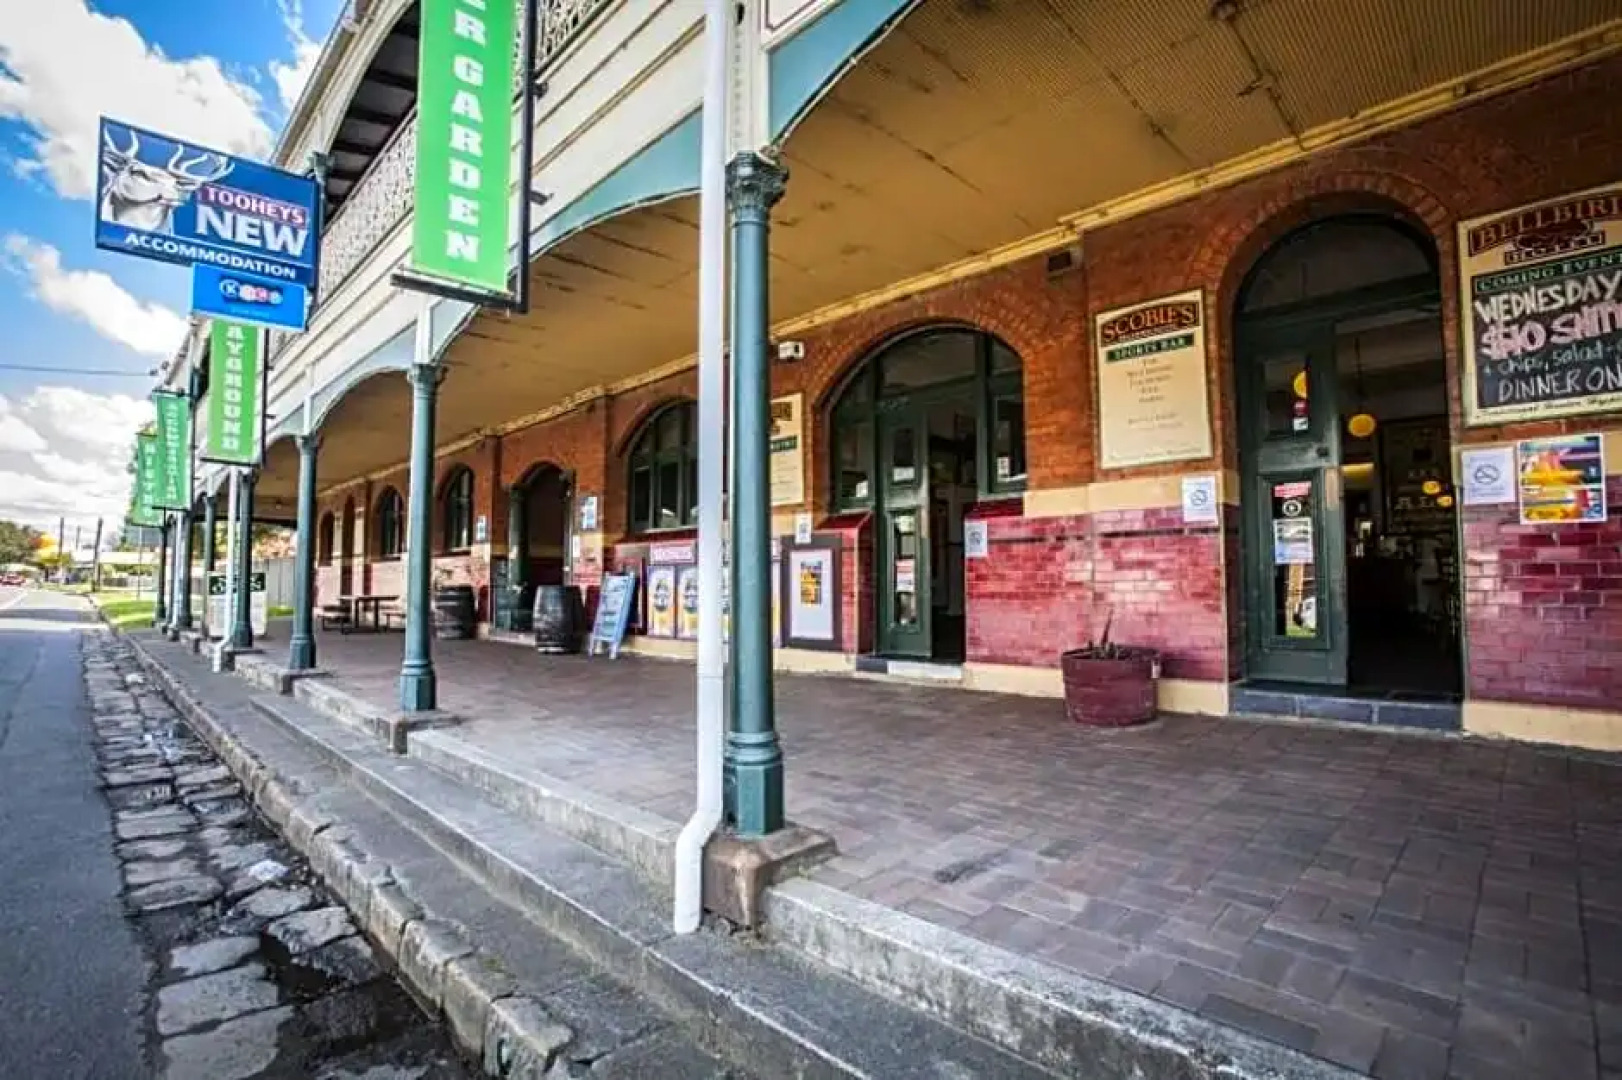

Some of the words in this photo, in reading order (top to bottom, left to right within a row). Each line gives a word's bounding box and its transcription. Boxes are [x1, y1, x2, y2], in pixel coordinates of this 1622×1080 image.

[454, 0, 487, 46] R
[445, 55, 484, 263] GARDEN
[206, 186, 304, 224] TOOHEYS
[196, 205, 308, 257] NEW
[124, 232, 296, 280] ACCOMMODATION
[1478, 265, 1554, 291] COMING
[1474, 269, 1622, 322] WEDNESDAY
[220, 326, 244, 450] AYGROUND
[1498, 368, 1582, 402] DINNER
